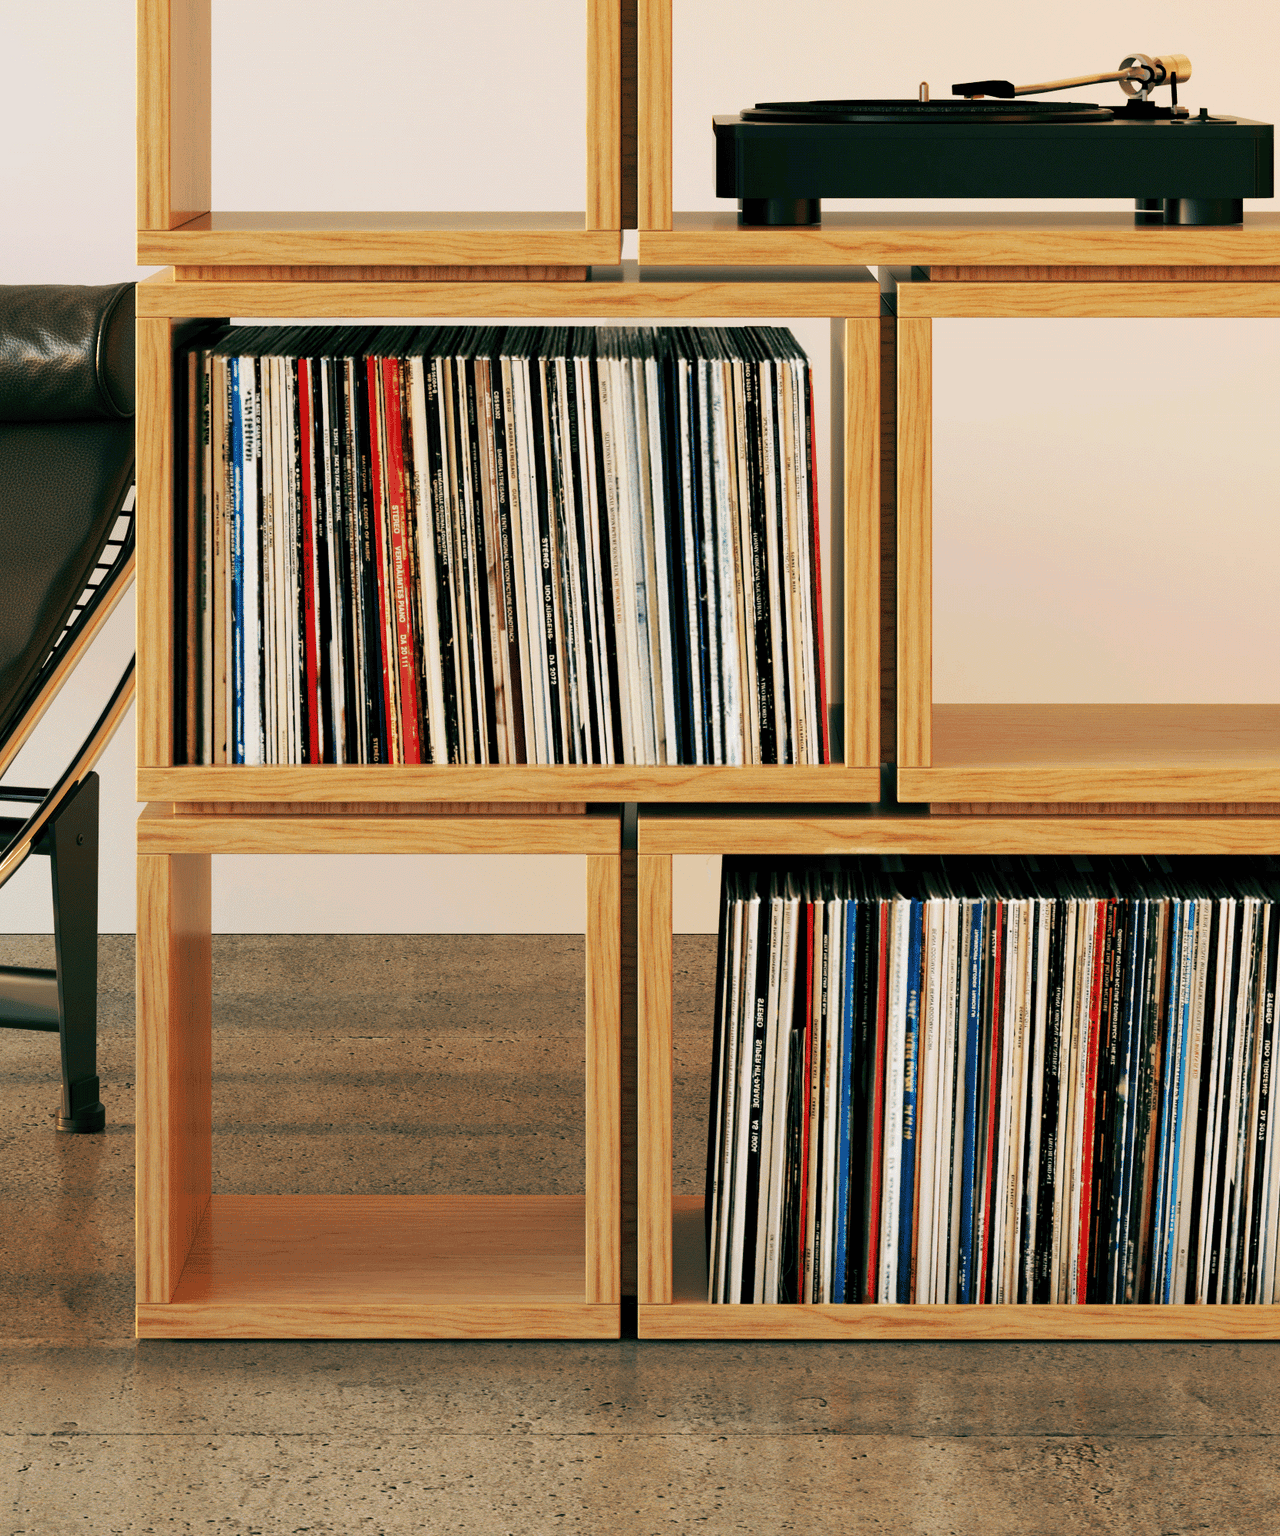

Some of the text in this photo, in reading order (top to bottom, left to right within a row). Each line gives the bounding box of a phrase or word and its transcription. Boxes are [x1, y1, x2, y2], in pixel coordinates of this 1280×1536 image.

[604, 432, 612, 458] SELECTIONS
[496, 449, 505, 472] BARBRA
[360, 455, 368, 492] MANTOVANI
[364, 531, 370, 540] OF
[436, 469, 445, 504] EMMANUELLE
[498, 472, 506, 503] STREISAND
[391, 505, 401, 534] STEREO
[440, 531, 449, 565] SOUNDTRACK
[502, 534, 510, 559] ORIGINAL
[394, 546, 405, 599] VERTRÄUMTES
[503, 560, 511, 582] MOTION
[753, 555, 761, 581] ORIGINAL
[504, 582, 513, 606] PICTURE
[544, 584, 552, 601] UDO
[755, 582, 763, 621] SOUNDTRACK
[397, 600, 406, 622] PIANO
[506, 606, 515, 643] SOUNDTRACK
[399, 634, 408, 645] DA
[548, 654, 556, 665] DA
[549, 667, 557, 685] 2072
